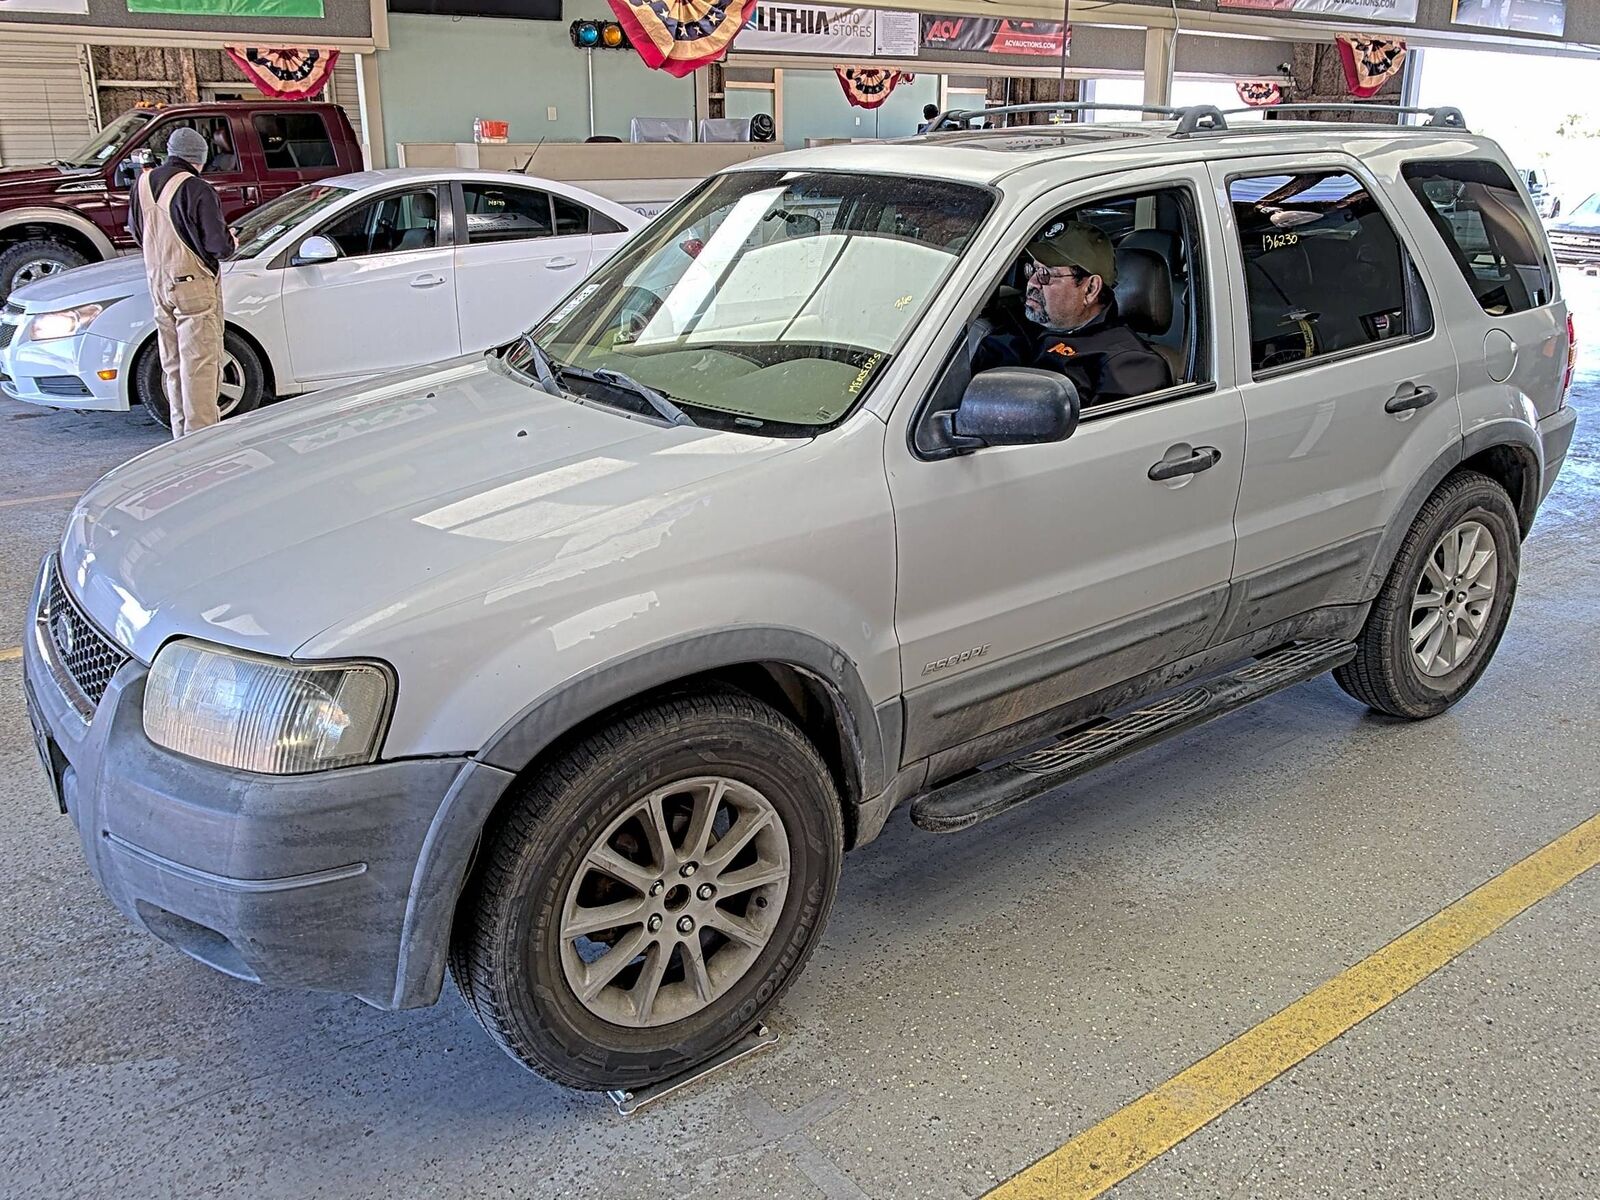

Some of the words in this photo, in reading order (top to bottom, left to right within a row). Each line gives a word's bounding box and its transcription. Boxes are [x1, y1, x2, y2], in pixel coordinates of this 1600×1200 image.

[757, 6, 830, 35] LITHIA
[833, 12, 860, 25] AUTO
[927, 18, 964, 40] ACV
[832, 25, 872, 38] STORES
[1004, 39, 1056, 49] ACVAUCTIONS.COM
[1262, 232, 1298, 251] 136230
[921, 642, 992, 676] ESCAPE
